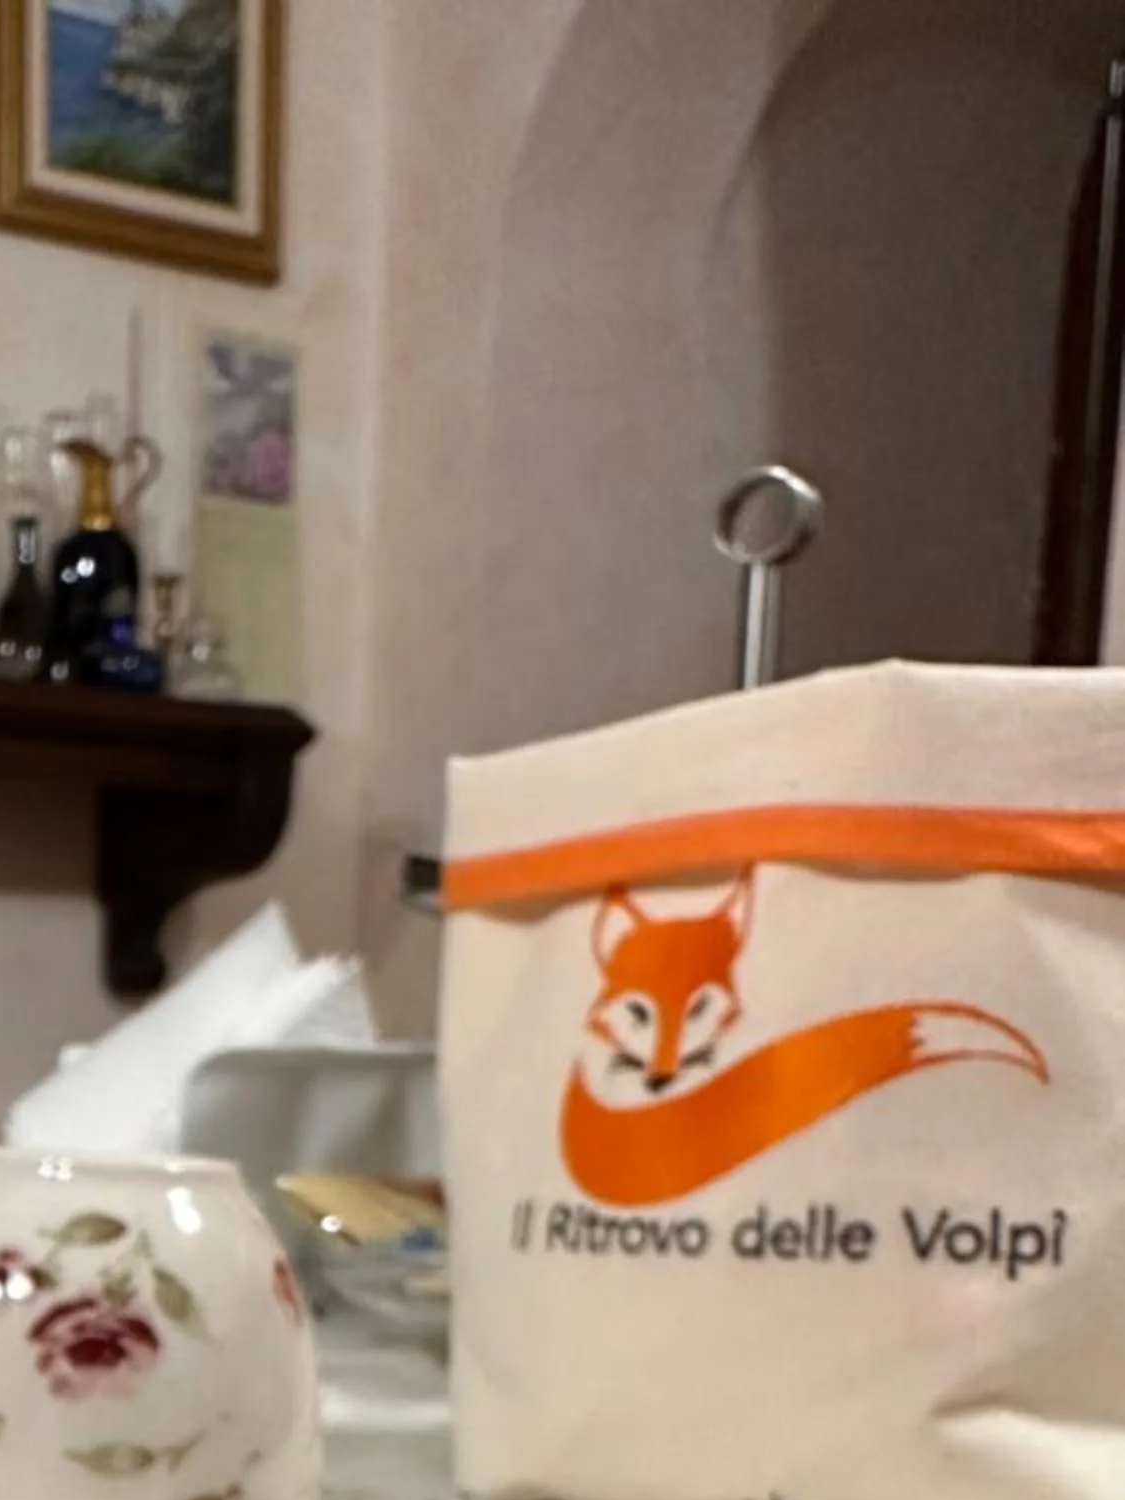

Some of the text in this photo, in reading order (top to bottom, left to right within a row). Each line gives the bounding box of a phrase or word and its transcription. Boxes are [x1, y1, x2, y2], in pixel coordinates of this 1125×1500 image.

[511, 1199, 1069, 1281] Il Ritrovo delle Volpi
